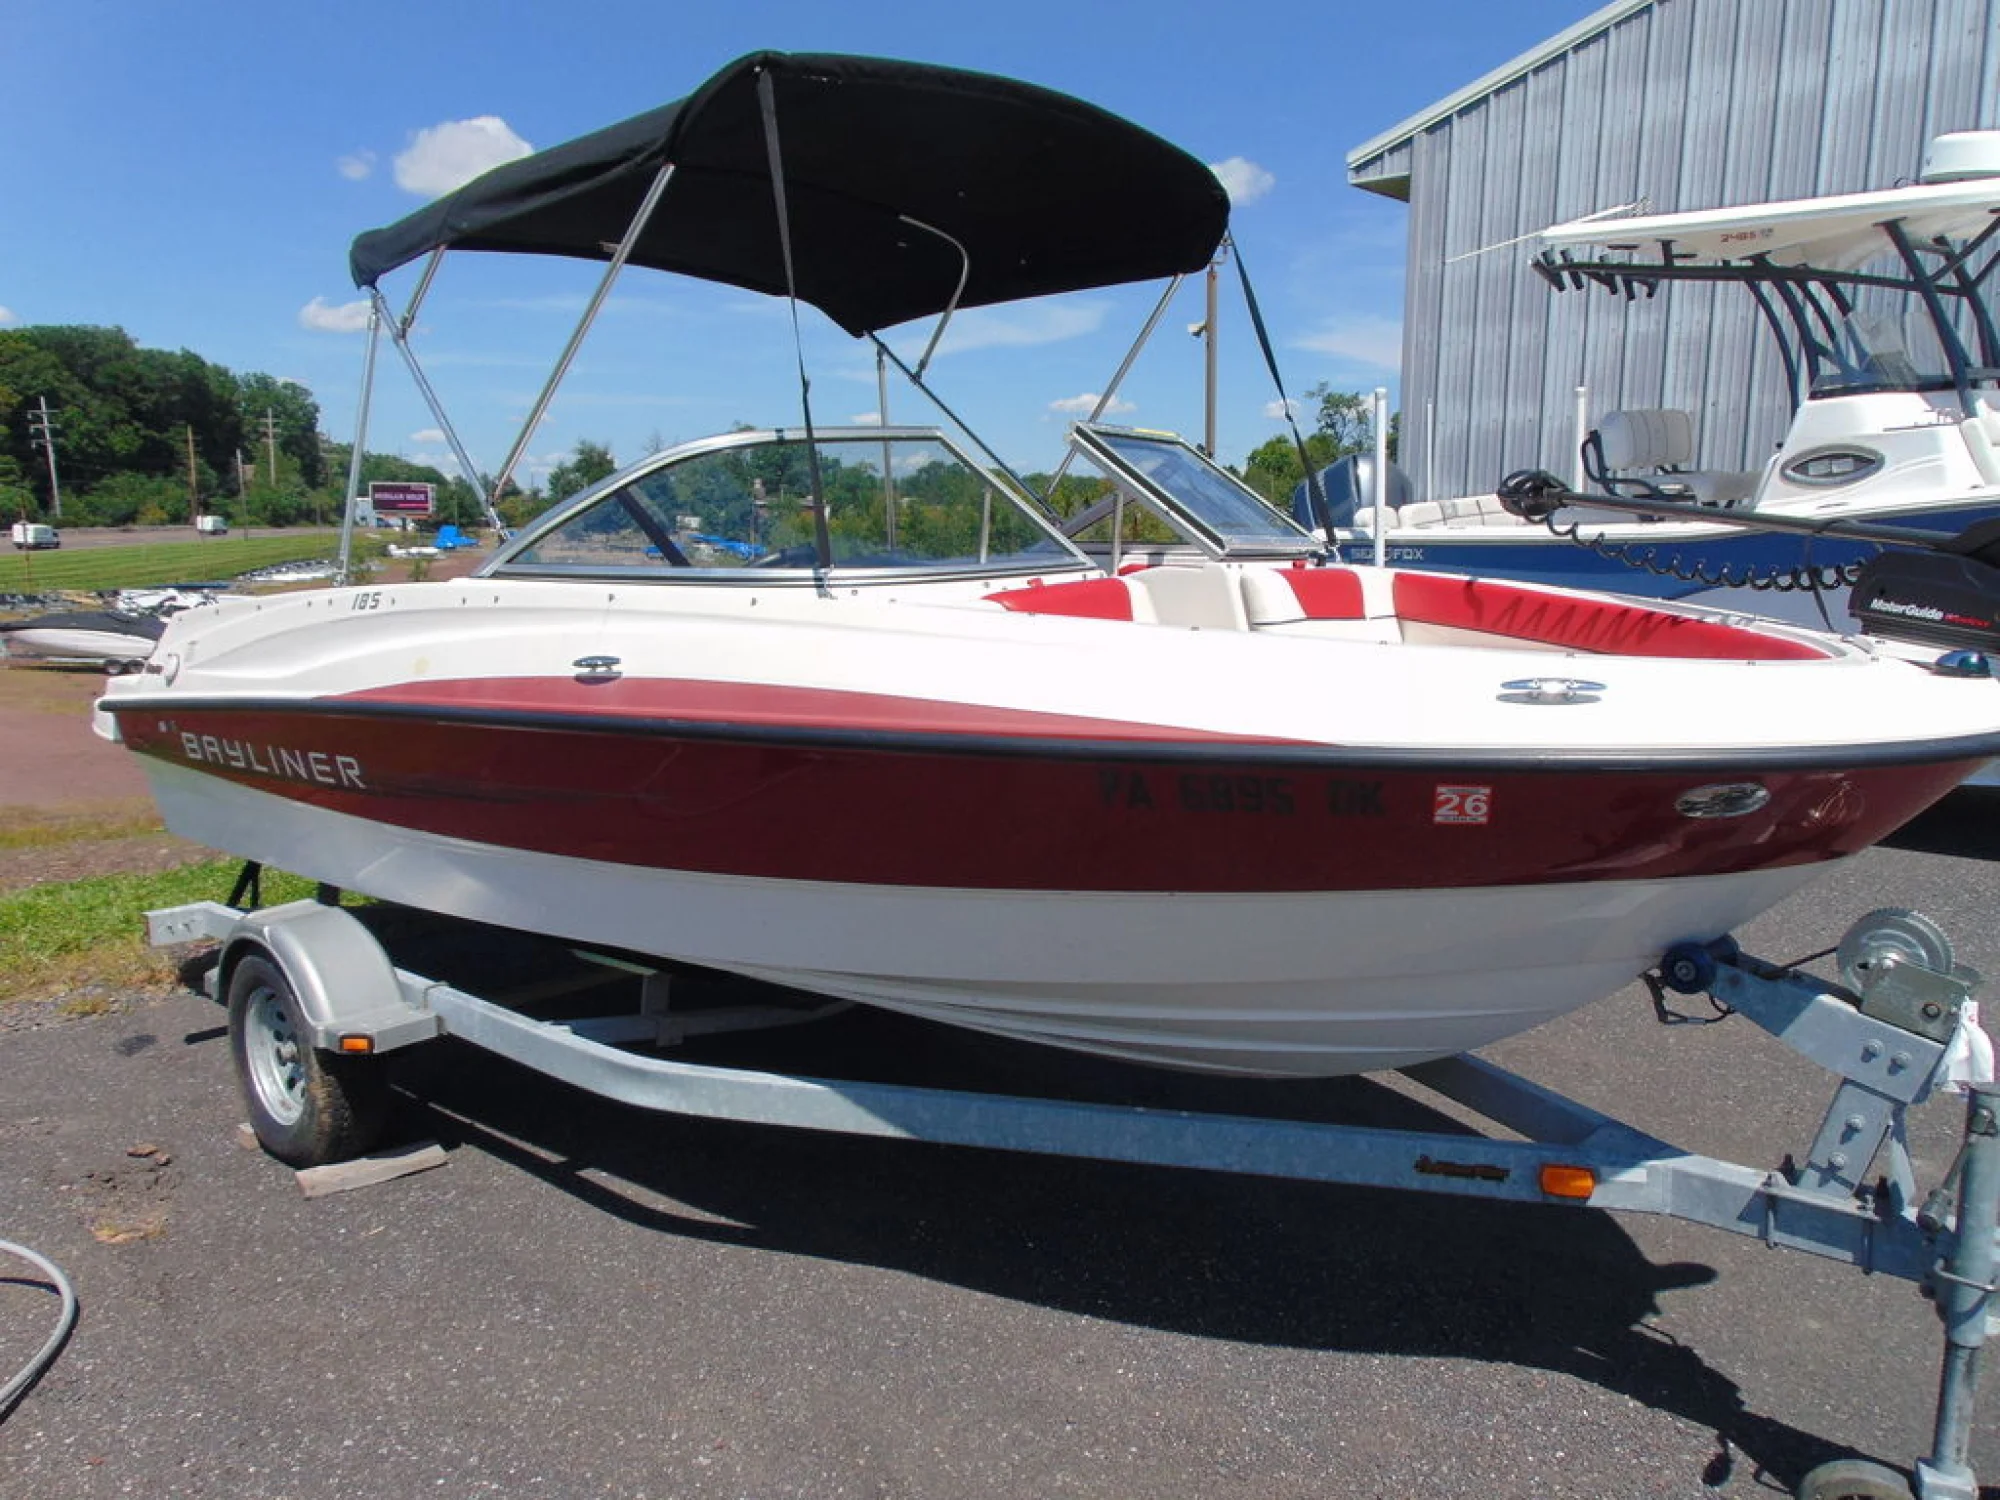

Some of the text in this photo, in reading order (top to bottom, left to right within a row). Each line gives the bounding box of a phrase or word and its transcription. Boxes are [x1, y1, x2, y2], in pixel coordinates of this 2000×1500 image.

[1393, 547, 1424, 560] FOX
[351, 591, 383, 610] 185
[1870, 598, 1944, 621] MotorGuide
[181, 731, 367, 790] BAYLINER
[1098, 767, 1155, 811] PA
[1436, 794, 1488, 816] 26
